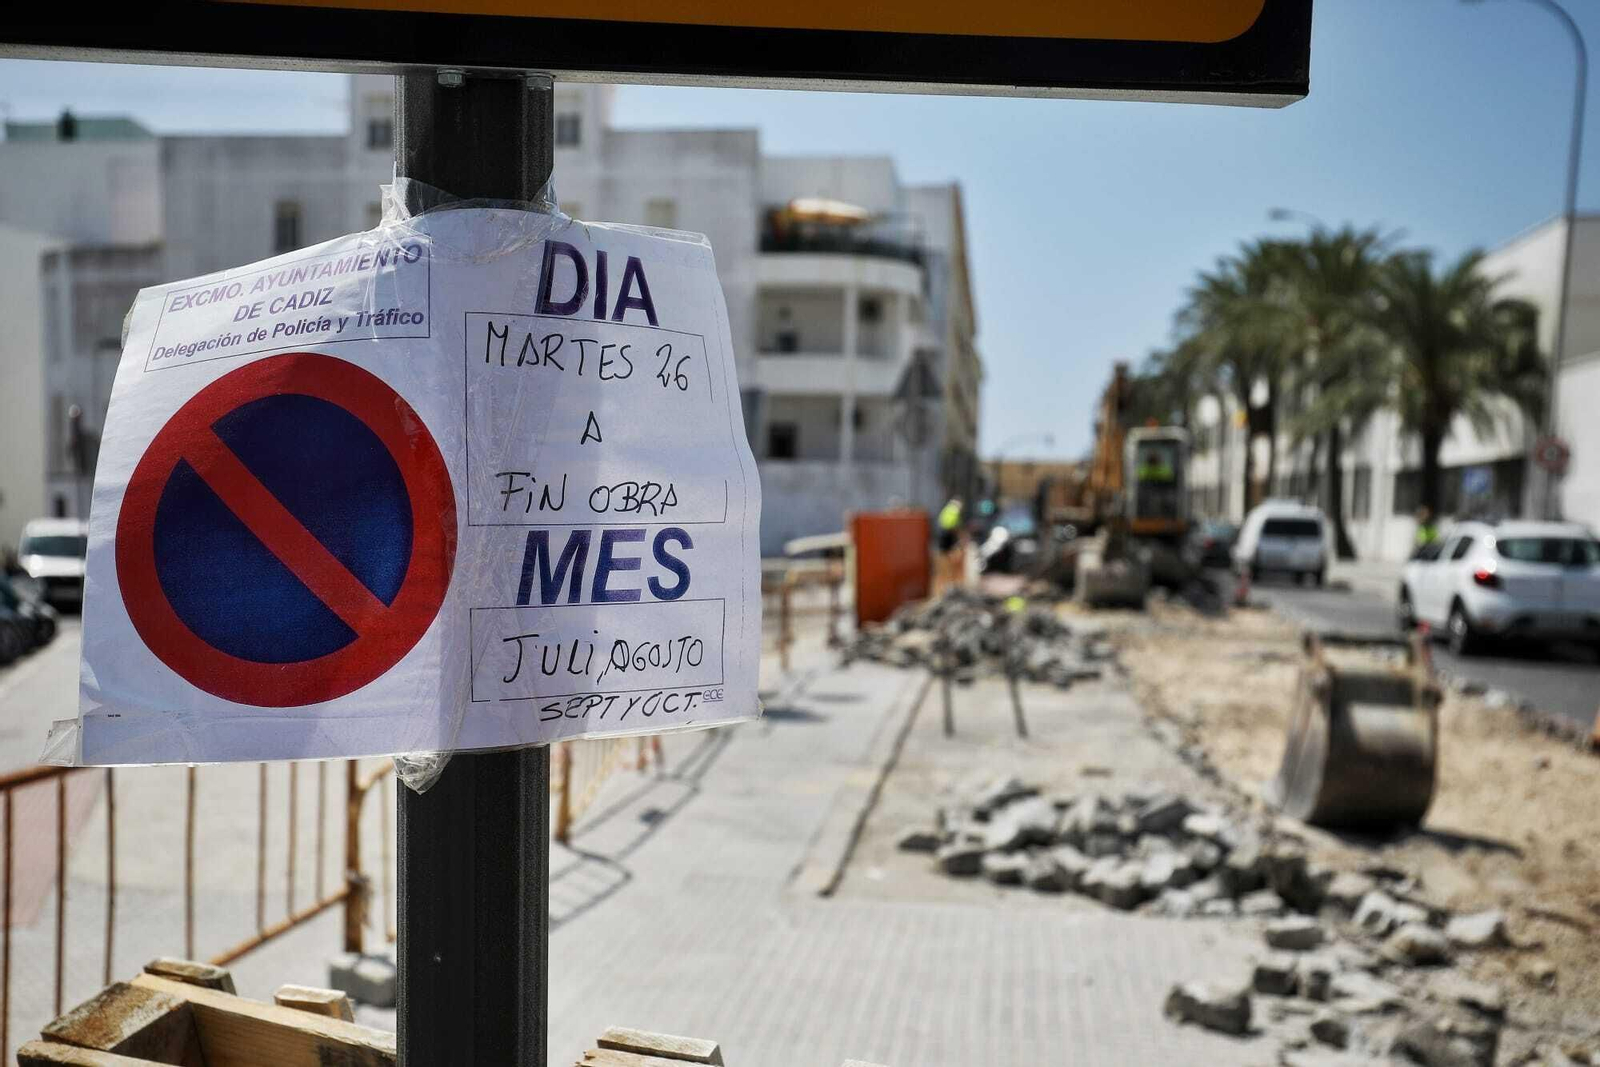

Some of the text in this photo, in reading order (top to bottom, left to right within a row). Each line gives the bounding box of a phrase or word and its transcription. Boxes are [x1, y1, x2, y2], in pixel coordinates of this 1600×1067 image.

[167, 244, 424, 313] EXCMO. AYUNTAMIENTO
[232, 287, 335, 323] DE CADIZ
[534, 239, 659, 327] DIA
[152, 308, 425, 361] Delegación de Policía y Tráfico
[485, 320, 692, 392] MARTES 26
[580, 410, 603, 445] A
[588, 480, 678, 516] OBRA
[516, 527, 694, 606] MES
